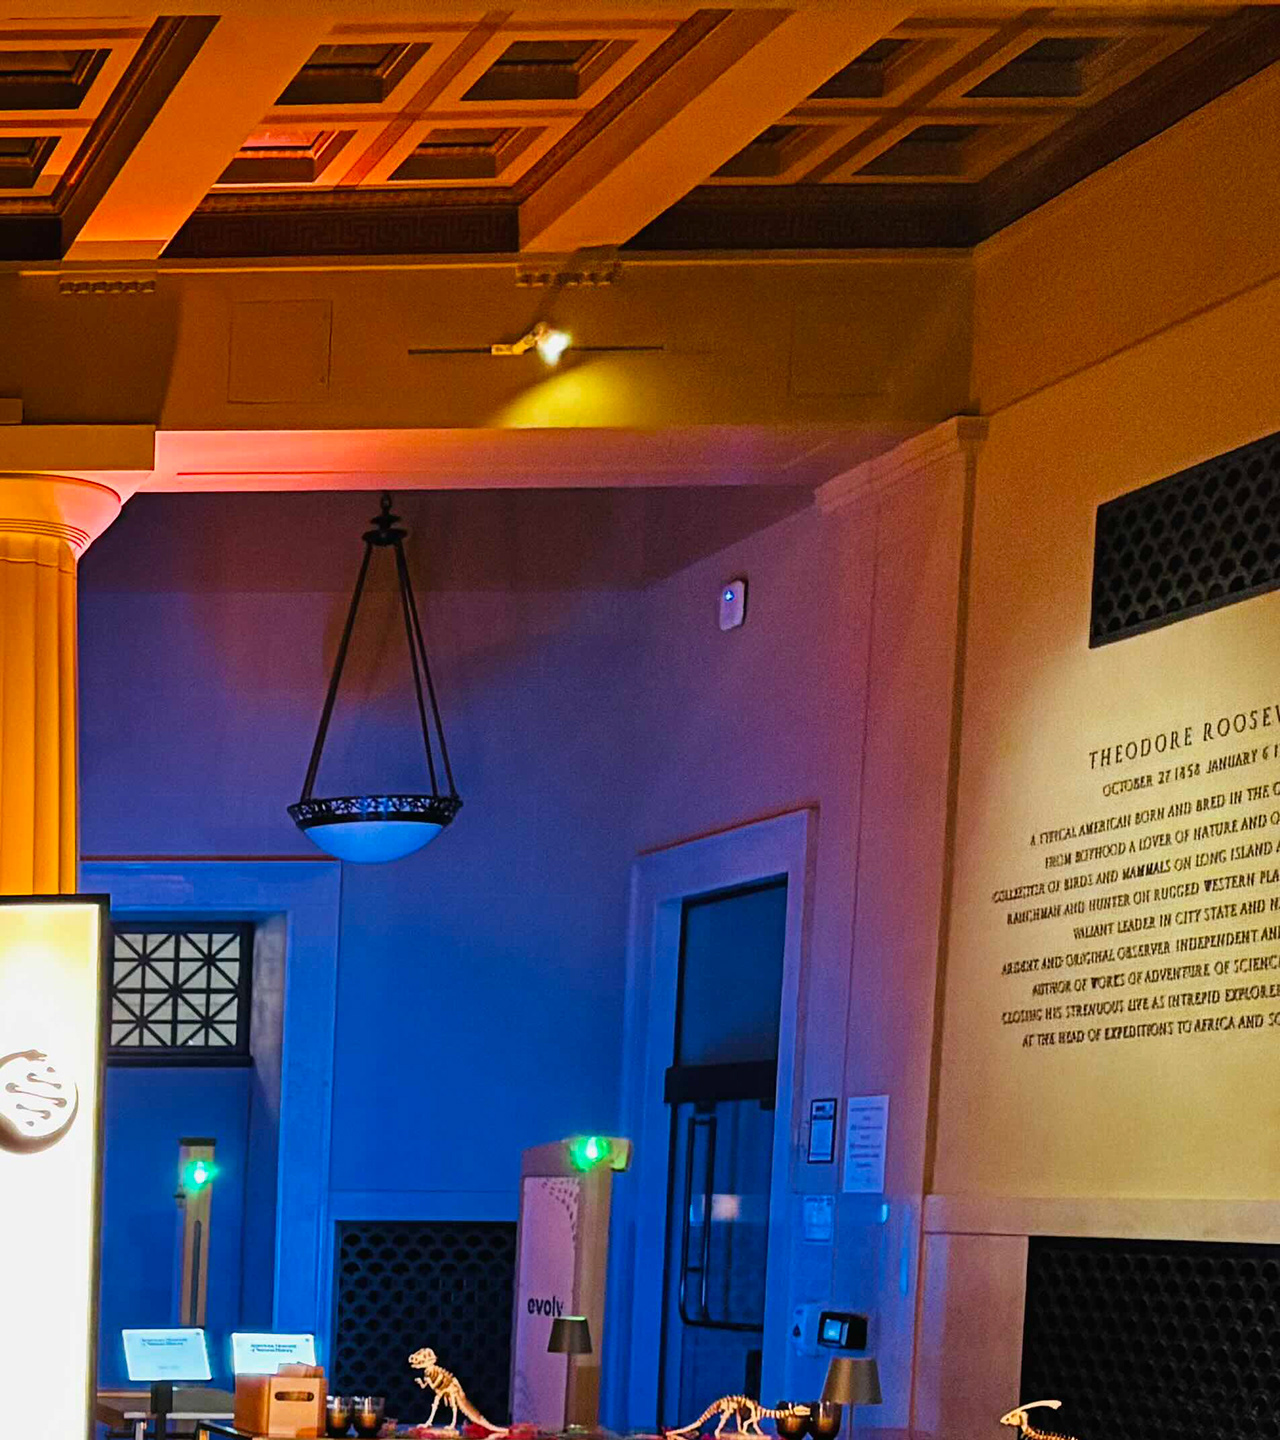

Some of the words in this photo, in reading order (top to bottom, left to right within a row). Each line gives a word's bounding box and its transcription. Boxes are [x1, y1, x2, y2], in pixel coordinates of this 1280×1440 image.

[1088, 726, 1192, 769] THEODORE
[1102, 774, 1153, 797] OCTOBER
[1157, 769, 1171, 785] 27
[1174, 762, 1200, 781] 1858
[1206, 748, 1258, 774] JANUARY
[1262, 745, 1269, 760] 6
[1030, 834, 1036, 846] A
[1078, 814, 1131, 837] AMERICAN
[1134, 807, 1165, 825] BORN
[1167, 801, 1191, 818] AND
[1195, 794, 1225, 812] BRED
[1230, 790, 1242, 805] IN
[1247, 784, 1270, 801] THE
[1129, 840, 1136, 853] A
[1138, 833, 1171, 851] LOVER
[1174, 828, 1189, 844] OF
[1193, 819, 1239, 841] NATURE
[1240, 814, 1268, 831] AND
[1063, 873, 1093, 891] BIRDS
[1095, 869, 1118, 885] AND
[1122, 859, 1171, 880] MAMMALS
[1174, 855, 1191, 872] ON
[1195, 849, 1226, 867] LONG
[1230, 841, 1273, 861] ISLAND
[1088, 893, 1130, 912] HUNTER
[1133, 889, 1150, 905] ON
[1154, 881, 1199, 901] RUGGED
[1203, 872, 1255, 892] WESTERN
[1117, 916, 1156, 934] LEADER
[1160, 913, 1172, 927] IN
[1175, 908, 1202, 925] CITY
[1203, 903, 1237, 921] STATE
[1239, 899, 1265, 915] AND
[1041, 955, 1064, 970] AND
[1176, 929, 1258, 952] INDEPENDENT
[1073, 977, 1087, 992] OF
[1127, 971, 1142, 985] OF
[1144, 963, 1210, 983] ADVENTURE
[1214, 960, 1229, 975] OF
[1151, 995, 1165, 1009] AS
[1168, 989, 1220, 1008] INTREPID
[1087, 1028, 1102, 1042] OF
[1104, 1021, 1173, 1041] EXPEDITIONS
[1177, 1019, 1192, 1034] TO
[1237, 1013, 1264, 1029] AND
[527, 1295, 564, 1317] evolv
